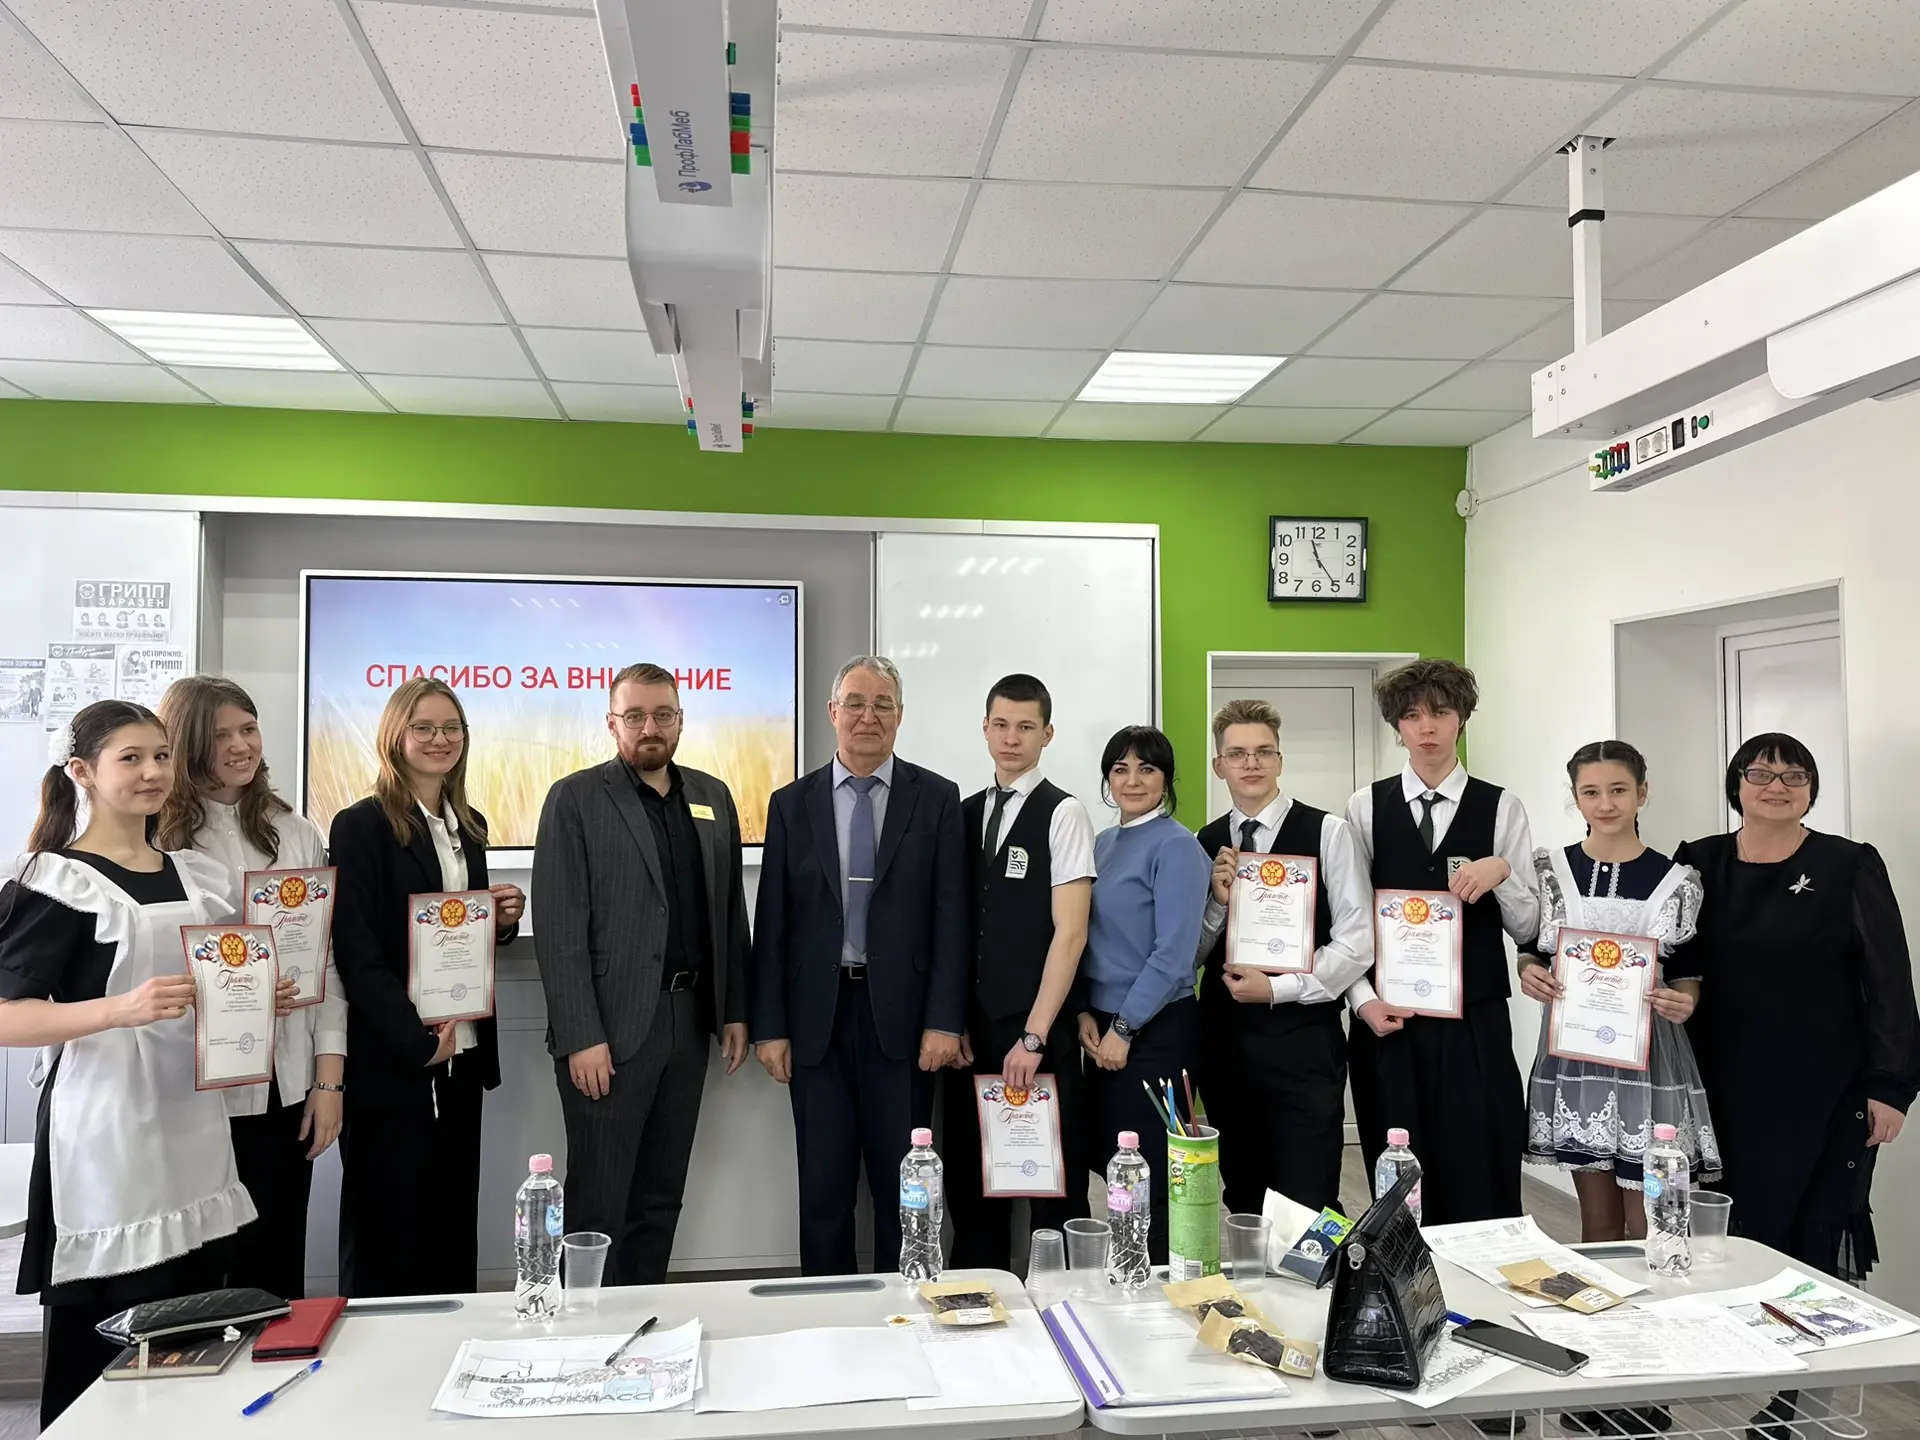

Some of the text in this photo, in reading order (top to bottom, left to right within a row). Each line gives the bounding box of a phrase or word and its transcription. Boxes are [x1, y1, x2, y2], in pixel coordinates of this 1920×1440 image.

[669, 109, 701, 178] ПрофЛабМеб
[1295, 526, 1339, 540] 11 12 1
[1278, 534, 1292, 547] 10
[1346, 535, 1357, 548] 2
[1279, 552, 1289, 565] 9
[1346, 554, 1356, 567] 3
[1278, 571, 1288, 584] 8
[1345, 573, 1355, 585] 4
[98, 583, 165, 599] ГРИПП
[1293, 580, 1340, 593] 7 6 5
[99, 597, 164, 607] ЗАРАЗЕН
[150, 660, 183, 670] ГРИПП!
[520, 665, 559, 689] ЗА
[567, 666, 731, 690] ВННИЕ
